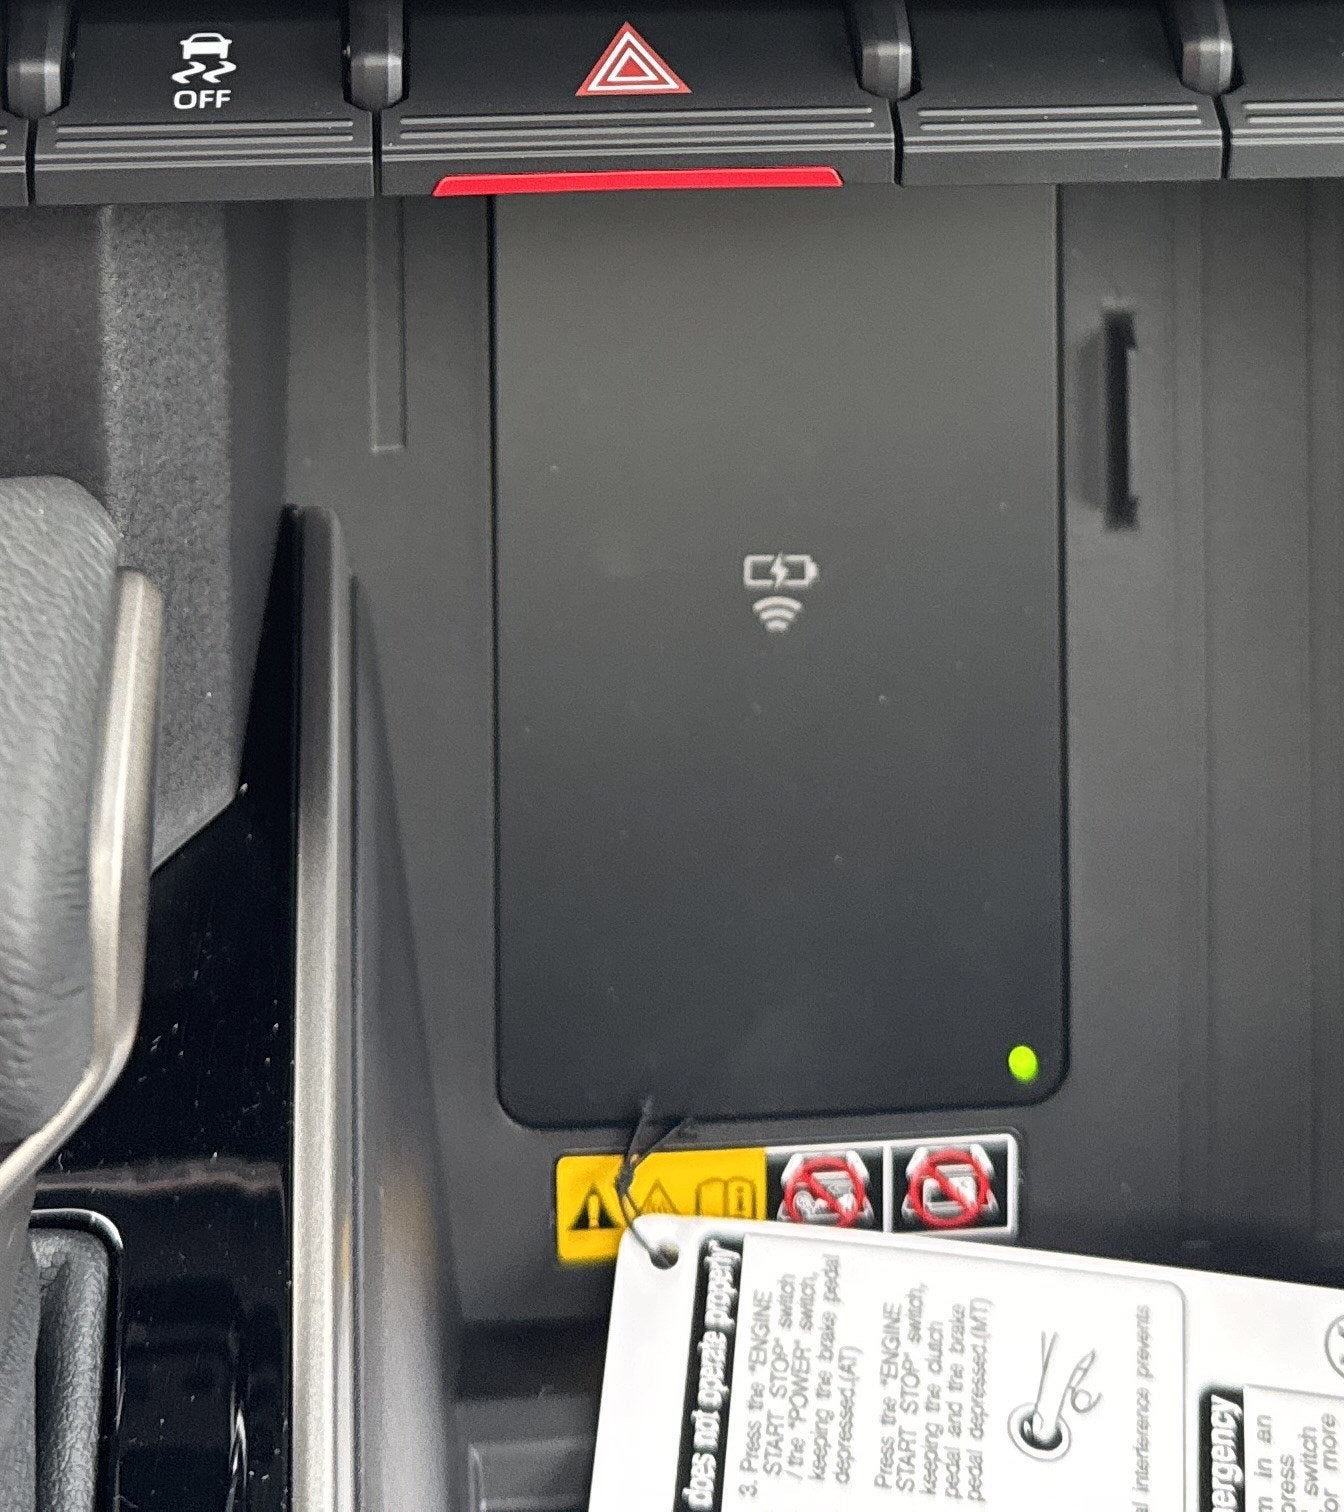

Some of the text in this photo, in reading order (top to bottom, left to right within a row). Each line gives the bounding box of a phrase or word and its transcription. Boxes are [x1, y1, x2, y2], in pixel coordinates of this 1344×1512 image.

[172, 89, 232, 110] OFF
[807, 1253, 843, 1481] keeping the brake pedal
[1135, 1304, 1156, 1381] prevents
[747, 1382, 766, 1412] the
[762, 1409, 785, 1477] START
[777, 1273, 797, 1332] switch
[944, 1303, 966, 1500] pedal and the brake
[690, 1409, 721, 1454] not
[880, 1396, 897, 1426] the
[919, 1320, 945, 1496] keeping the clutch
[1256, 1413, 1273, 1445] an
[739, 1420, 763, 1474] Press
[787, 1436, 806, 1468] the
[873, 1435, 896, 1489] Press
[895, 1424, 917, 1492] START
[1131, 1386, 1153, 1494] interference
[1298, 1426, 1320, 1498] switch
[1321, 1413, 1340, 1472] more
[966, 1449, 987, 1503] pedal
[1253, 1458, 1273, 1480] in
